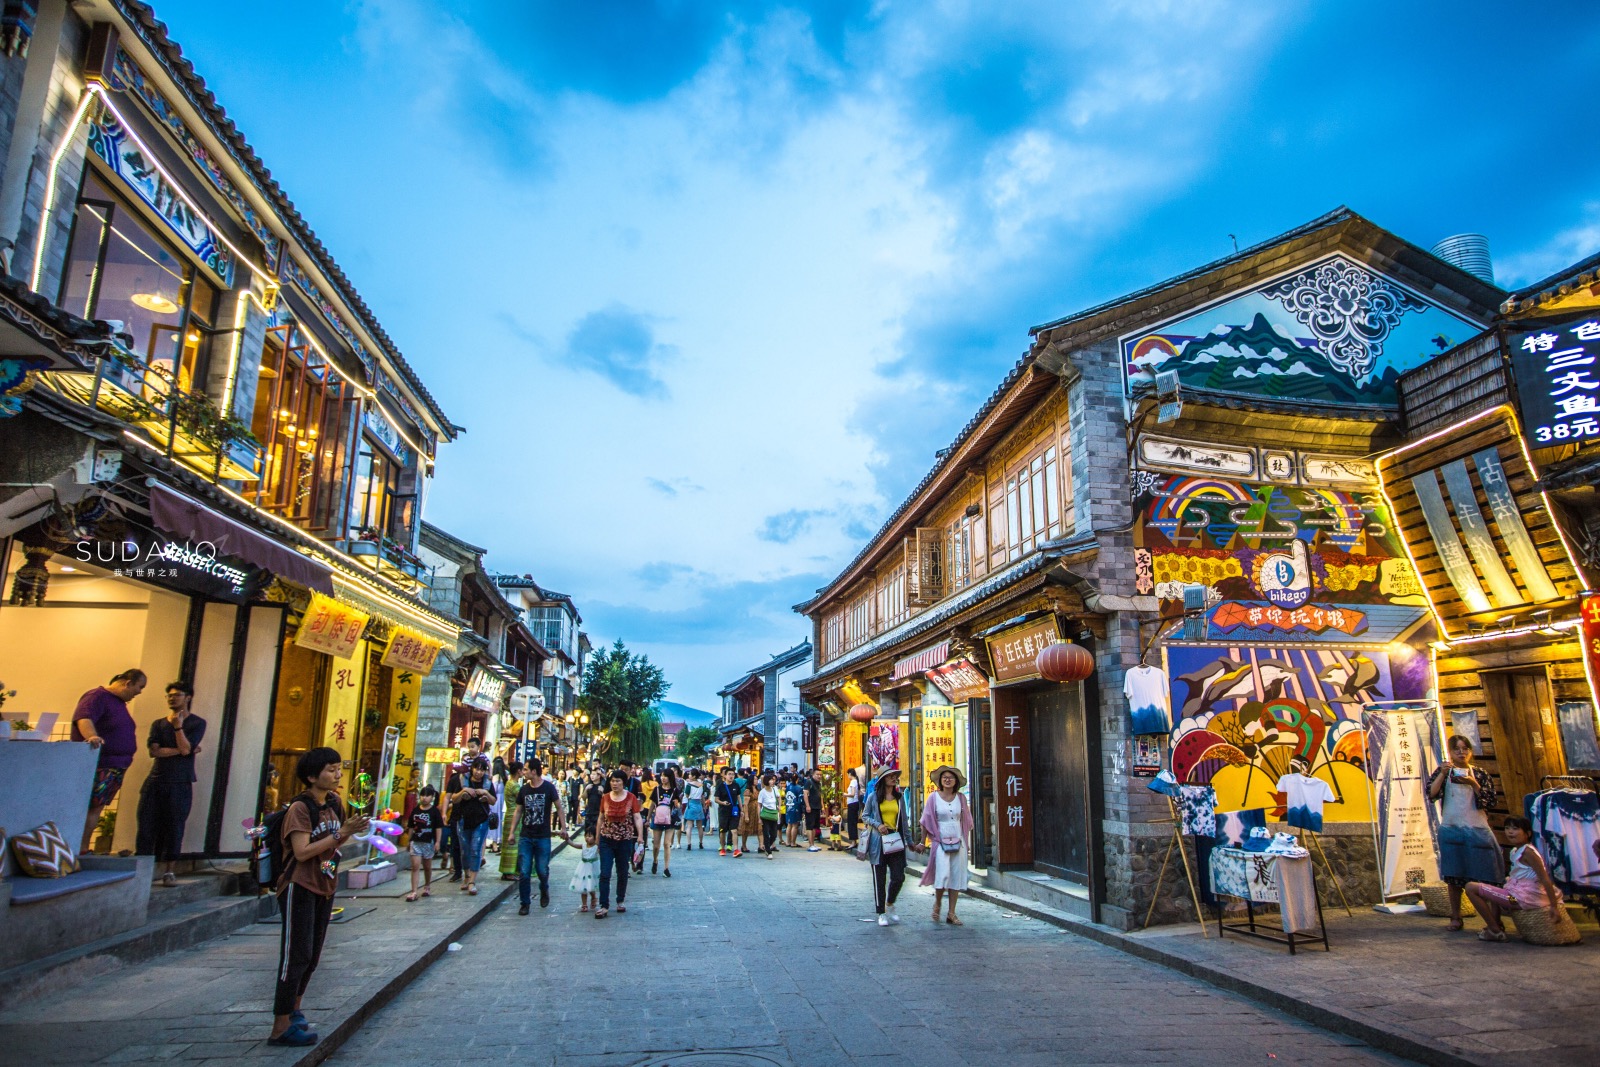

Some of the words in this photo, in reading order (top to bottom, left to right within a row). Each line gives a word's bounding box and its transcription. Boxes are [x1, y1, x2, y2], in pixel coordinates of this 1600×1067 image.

[1520, 321, 1600, 353] 特色
[1545, 347, 1600, 419] 三文鱼
[1535, 417, 1600, 441] 38元
[211, 563, 247, 586] COFFEE
[1270, 589, 1307, 604] bikego
[1249, 607, 1345, 627] 带你玩个够
[1005, 628, 1057, 663] 任氏鲜花饼
[1396, 715, 1413, 775] 蓝染体验课
[1004, 715, 1024, 828] 手工作饼
